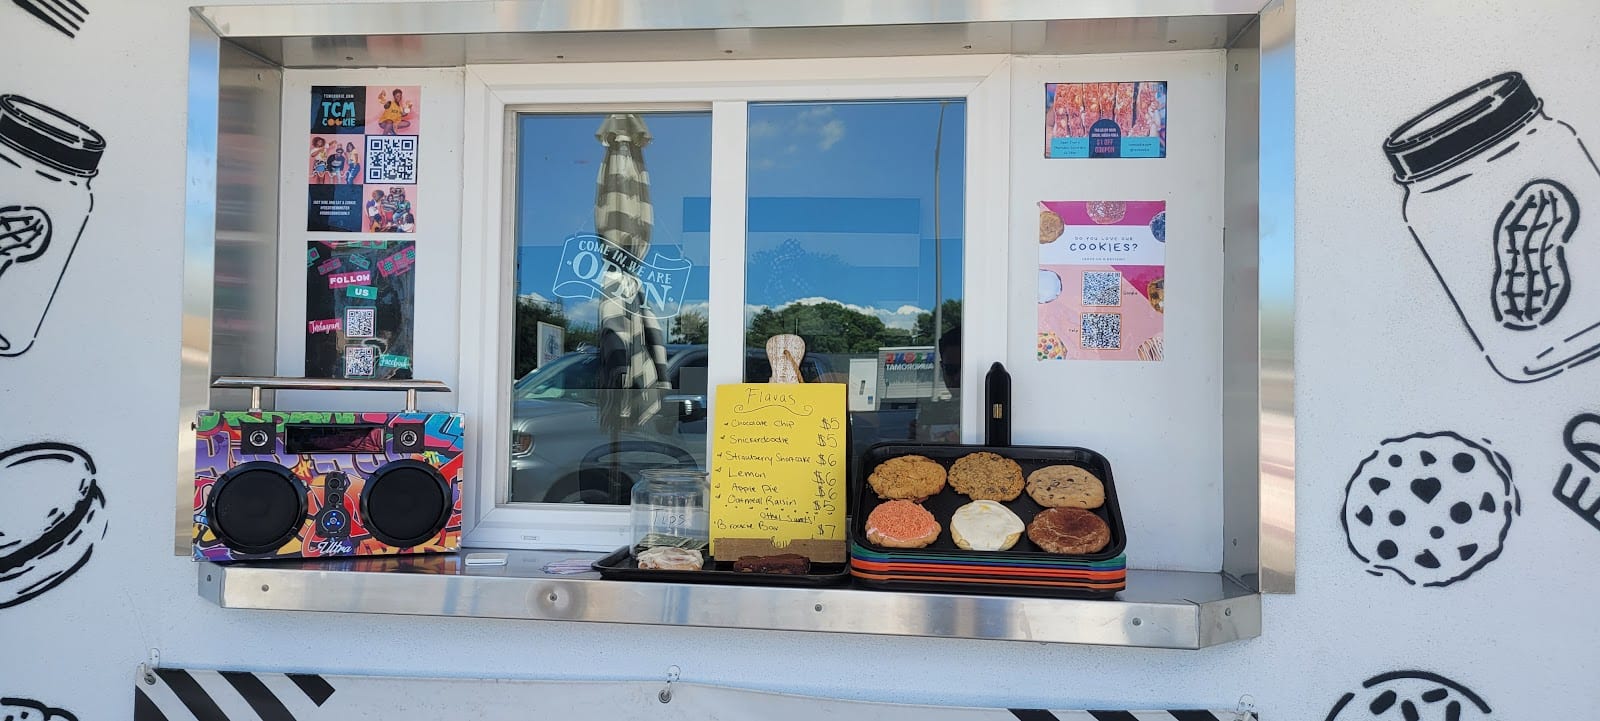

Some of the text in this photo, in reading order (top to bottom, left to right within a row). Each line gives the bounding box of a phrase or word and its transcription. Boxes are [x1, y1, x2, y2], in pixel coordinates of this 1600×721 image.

[322, 102, 355, 117] TCM
[322, 118, 355, 126] COOKIE
[1070, 242, 1138, 252] COOKIES?
[579, 240, 672, 284] COME IN, WE ARE
[330, 274, 370, 285] FOLLOW
[573, 251, 672, 312] OPEN
[355, 288, 369, 297] US
[309, 321, 340, 334] Instagram
[745, 387, 796, 405] Flavas
[730, 417, 840, 430] Chocolate Chip $5
[729, 432, 838, 448] Snickerdoodle $5
[725, 451, 837, 467] Strawberry Shortcake $6
[728, 467, 837, 486] Lemon $6
[731, 482, 837, 500] Apple Pie $6
[727, 495, 836, 512] Oatmeal Raisin $5
[817, 524, 836, 539] $7
[318, 541, 352, 554] Ultra
